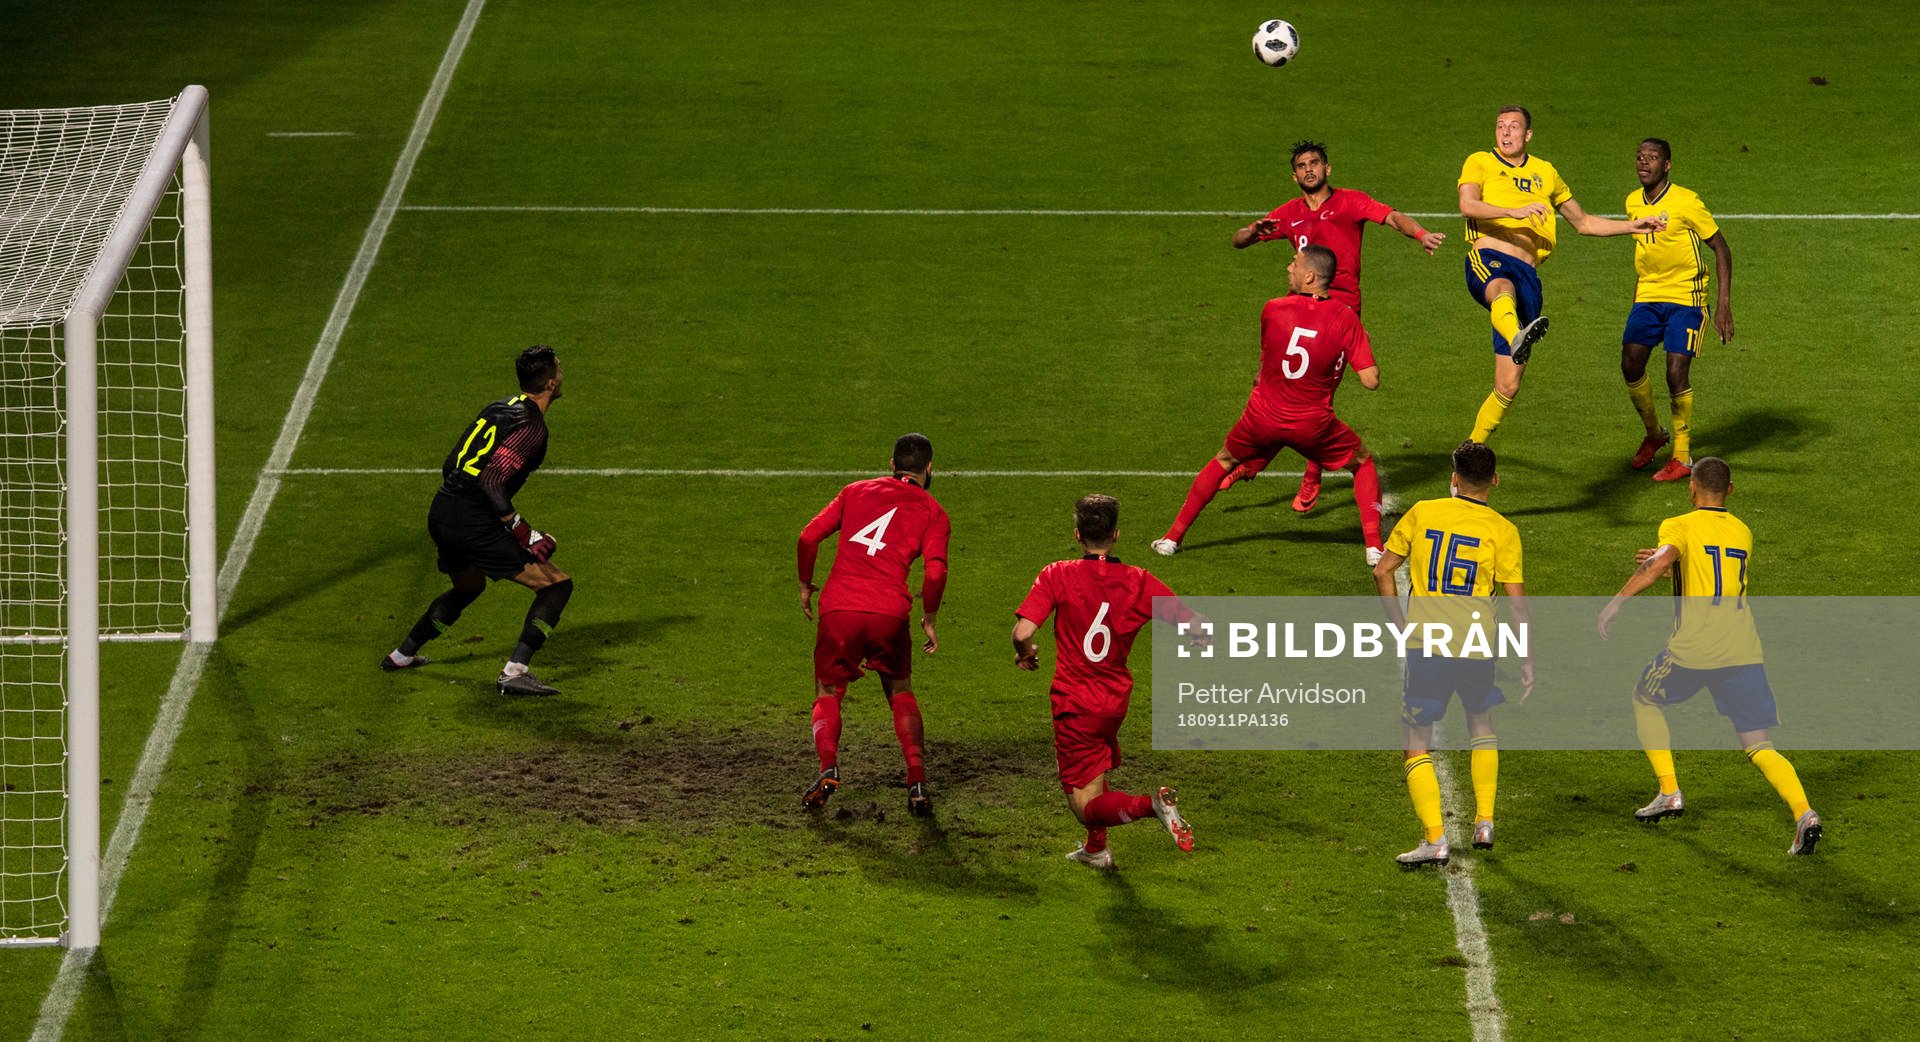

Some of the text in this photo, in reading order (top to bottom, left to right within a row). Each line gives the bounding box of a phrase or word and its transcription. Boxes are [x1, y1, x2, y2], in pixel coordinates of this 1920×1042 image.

[1281, 326, 1318, 380] 5
[1686, 327, 1699, 352] 11
[456, 417, 497, 477] 12
[849, 506, 898, 557] 4
[1425, 528, 1481, 597] 16
[1704, 545, 1749, 610] 17
[1082, 601, 1111, 663] 6
